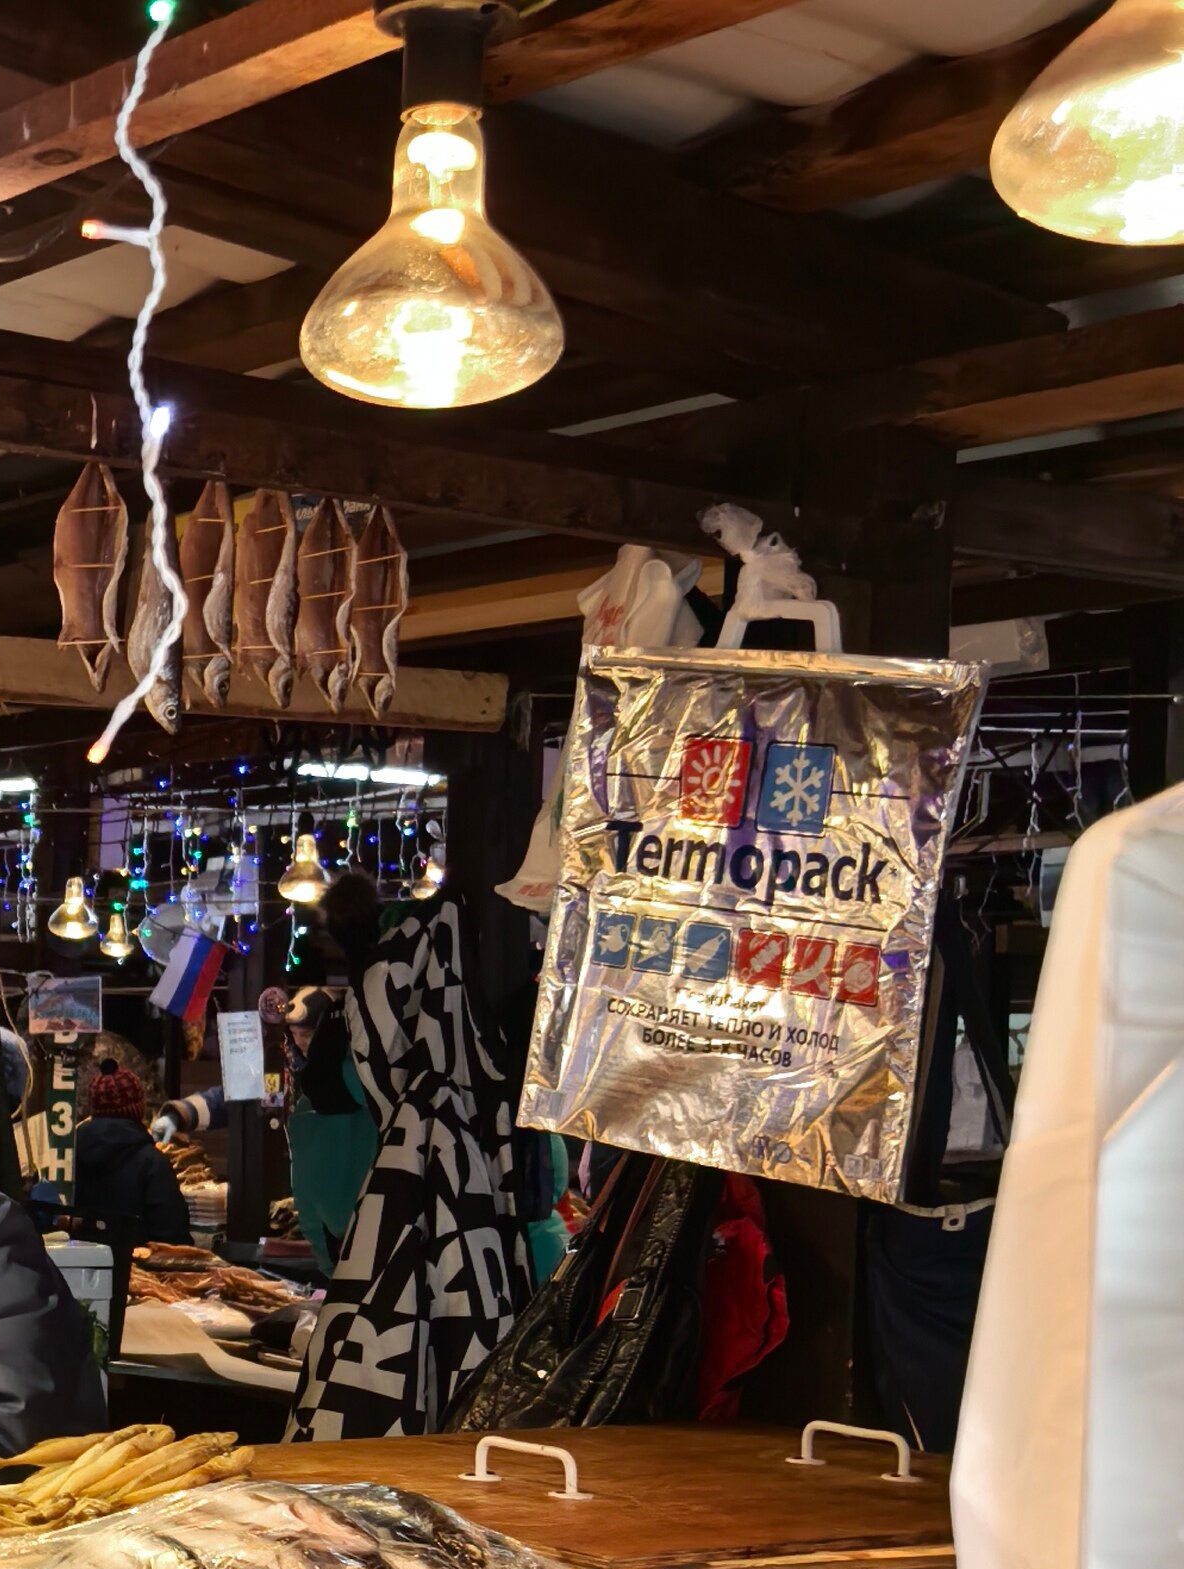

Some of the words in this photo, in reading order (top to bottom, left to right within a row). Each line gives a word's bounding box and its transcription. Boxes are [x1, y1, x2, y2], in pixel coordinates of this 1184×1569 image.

[642, 1027, 696, 1052] БОЛЕЕ
[737, 1044, 792, 1067] ЧАСОВ
[707, 1014, 764, 1037] ТЕПЛО
[769, 1024, 782, 1040] И
[785, 1026, 840, 1054] ХОЛОД
